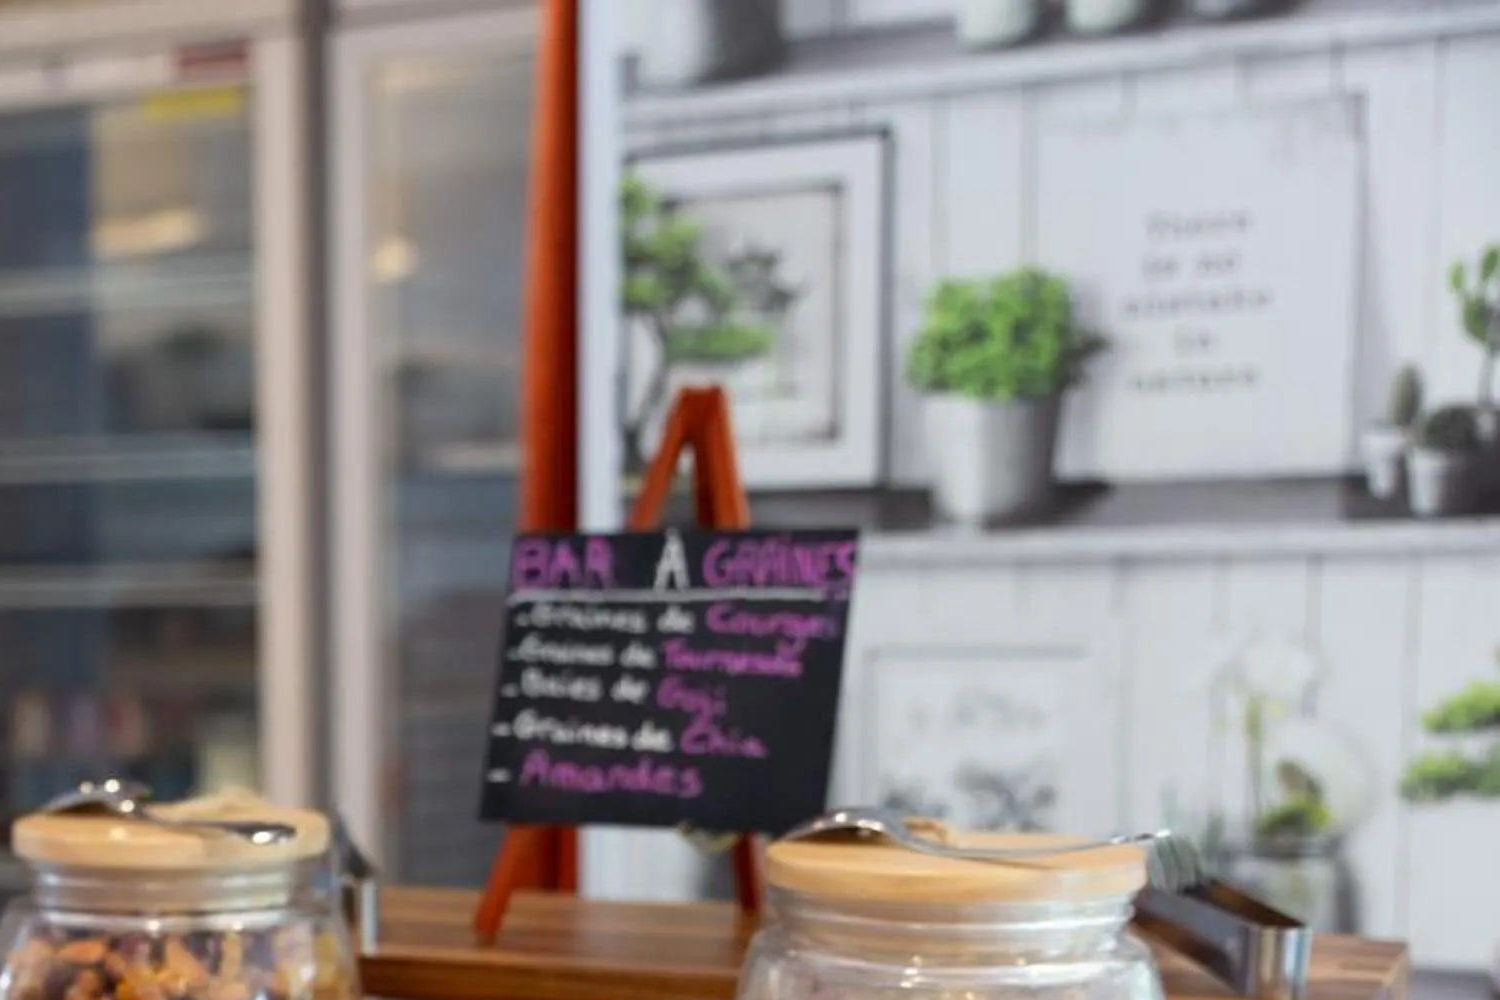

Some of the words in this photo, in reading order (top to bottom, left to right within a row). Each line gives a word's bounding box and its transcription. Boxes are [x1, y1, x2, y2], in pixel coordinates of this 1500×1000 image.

[512, 537, 614, 589] BAR
[657, 604, 696, 634] de
[619, 641, 657, 668] de
[610, 673, 650, 704] de
[512, 708, 628, 750] Graines
[631, 721, 673, 753] de
[680, 717, 770, 758] Chia
[519, 749, 703, 798] Amandes
